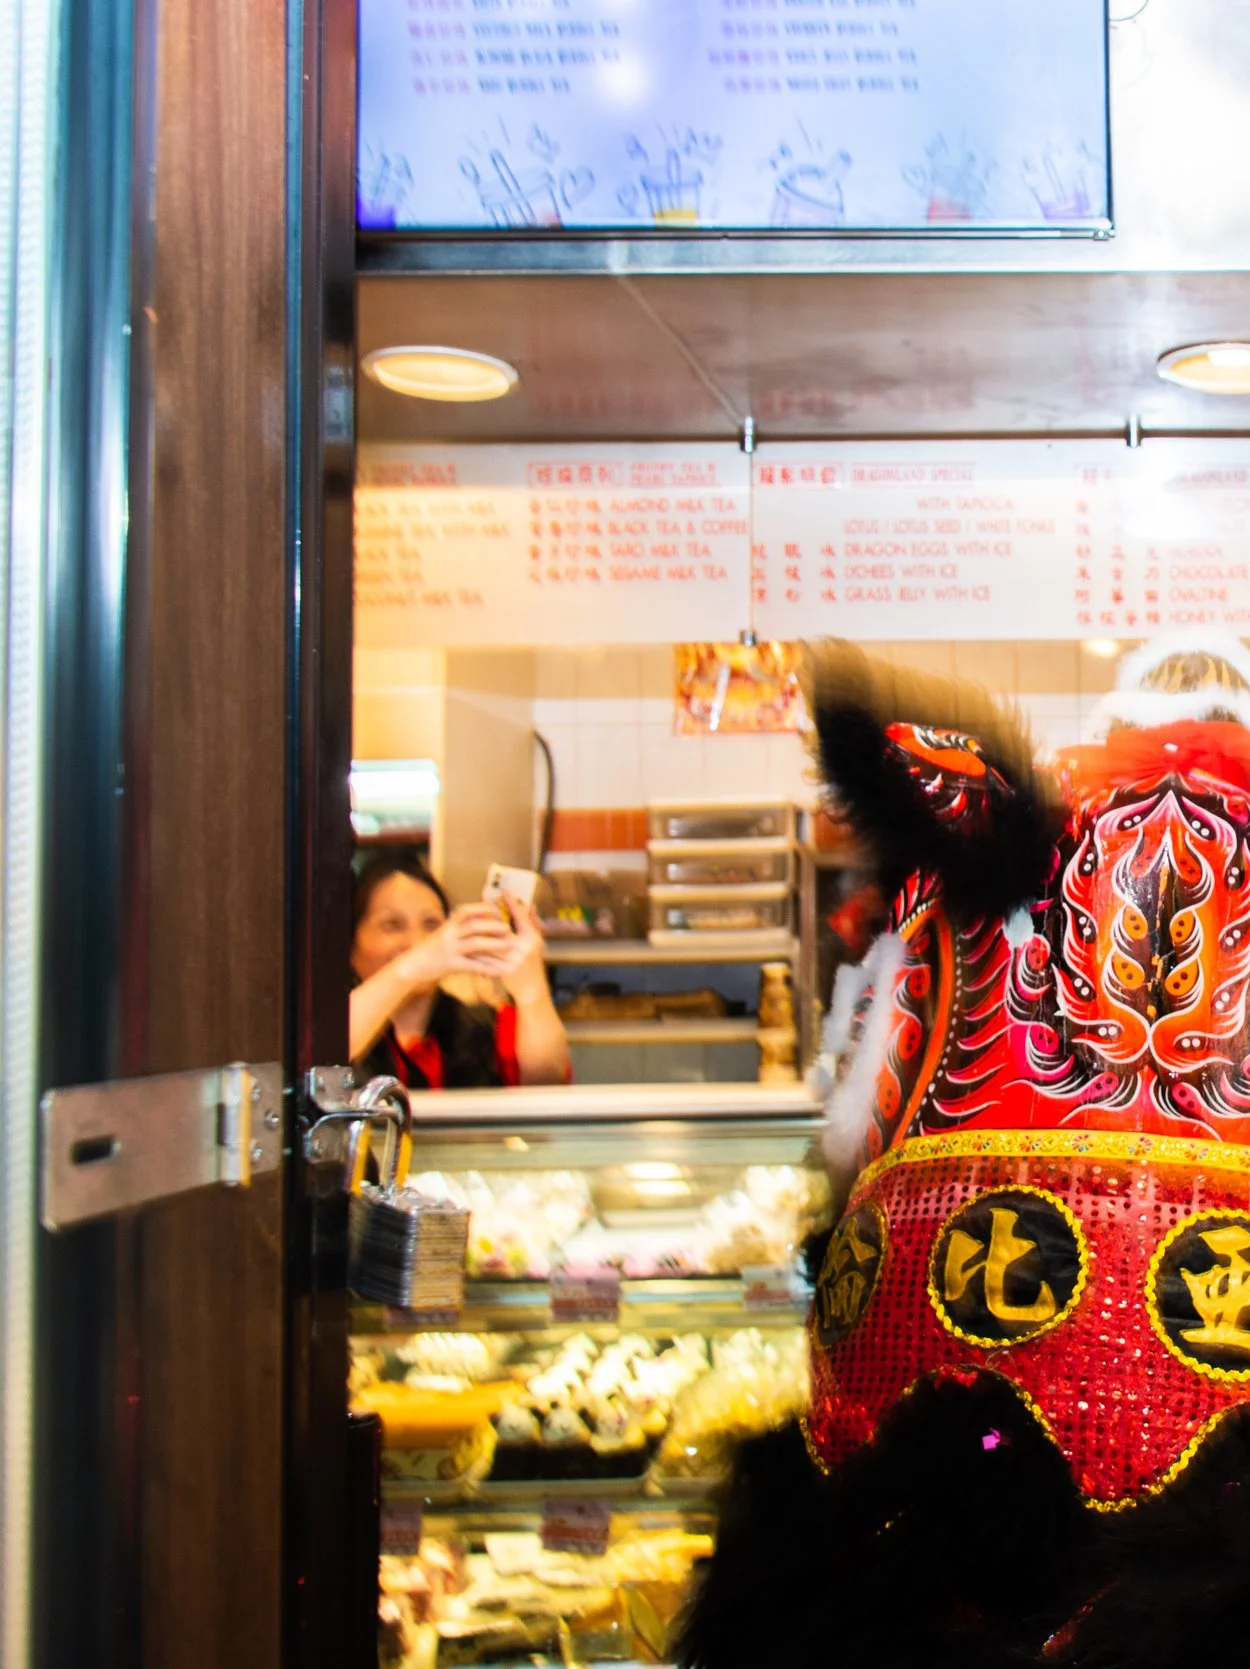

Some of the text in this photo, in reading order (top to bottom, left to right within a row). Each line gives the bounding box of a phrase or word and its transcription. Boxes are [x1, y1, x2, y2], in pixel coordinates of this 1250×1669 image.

[609, 498, 670, 514] ALMOND
[676, 498, 705, 514] MILK
[710, 498, 736, 514] TEA
[609, 520, 651, 536] BLACK
[656, 520, 680, 536] TEA
[650, 542, 680, 559] MILK
[686, 542, 712, 559] TEA
[844, 542, 1013, 558] DRAGON EGGS WITH ICE
[667, 565, 697, 581] MILK
[702, 565, 729, 581] TEA
[844, 564, 959, 579] LYCHEES WITH ICE
[1169, 564, 1250, 580] CHOCOLATE
[844, 586, 991, 601] GRASS JELLY WITH ICE
[1169, 587, 1229, 602] OVALTINE
